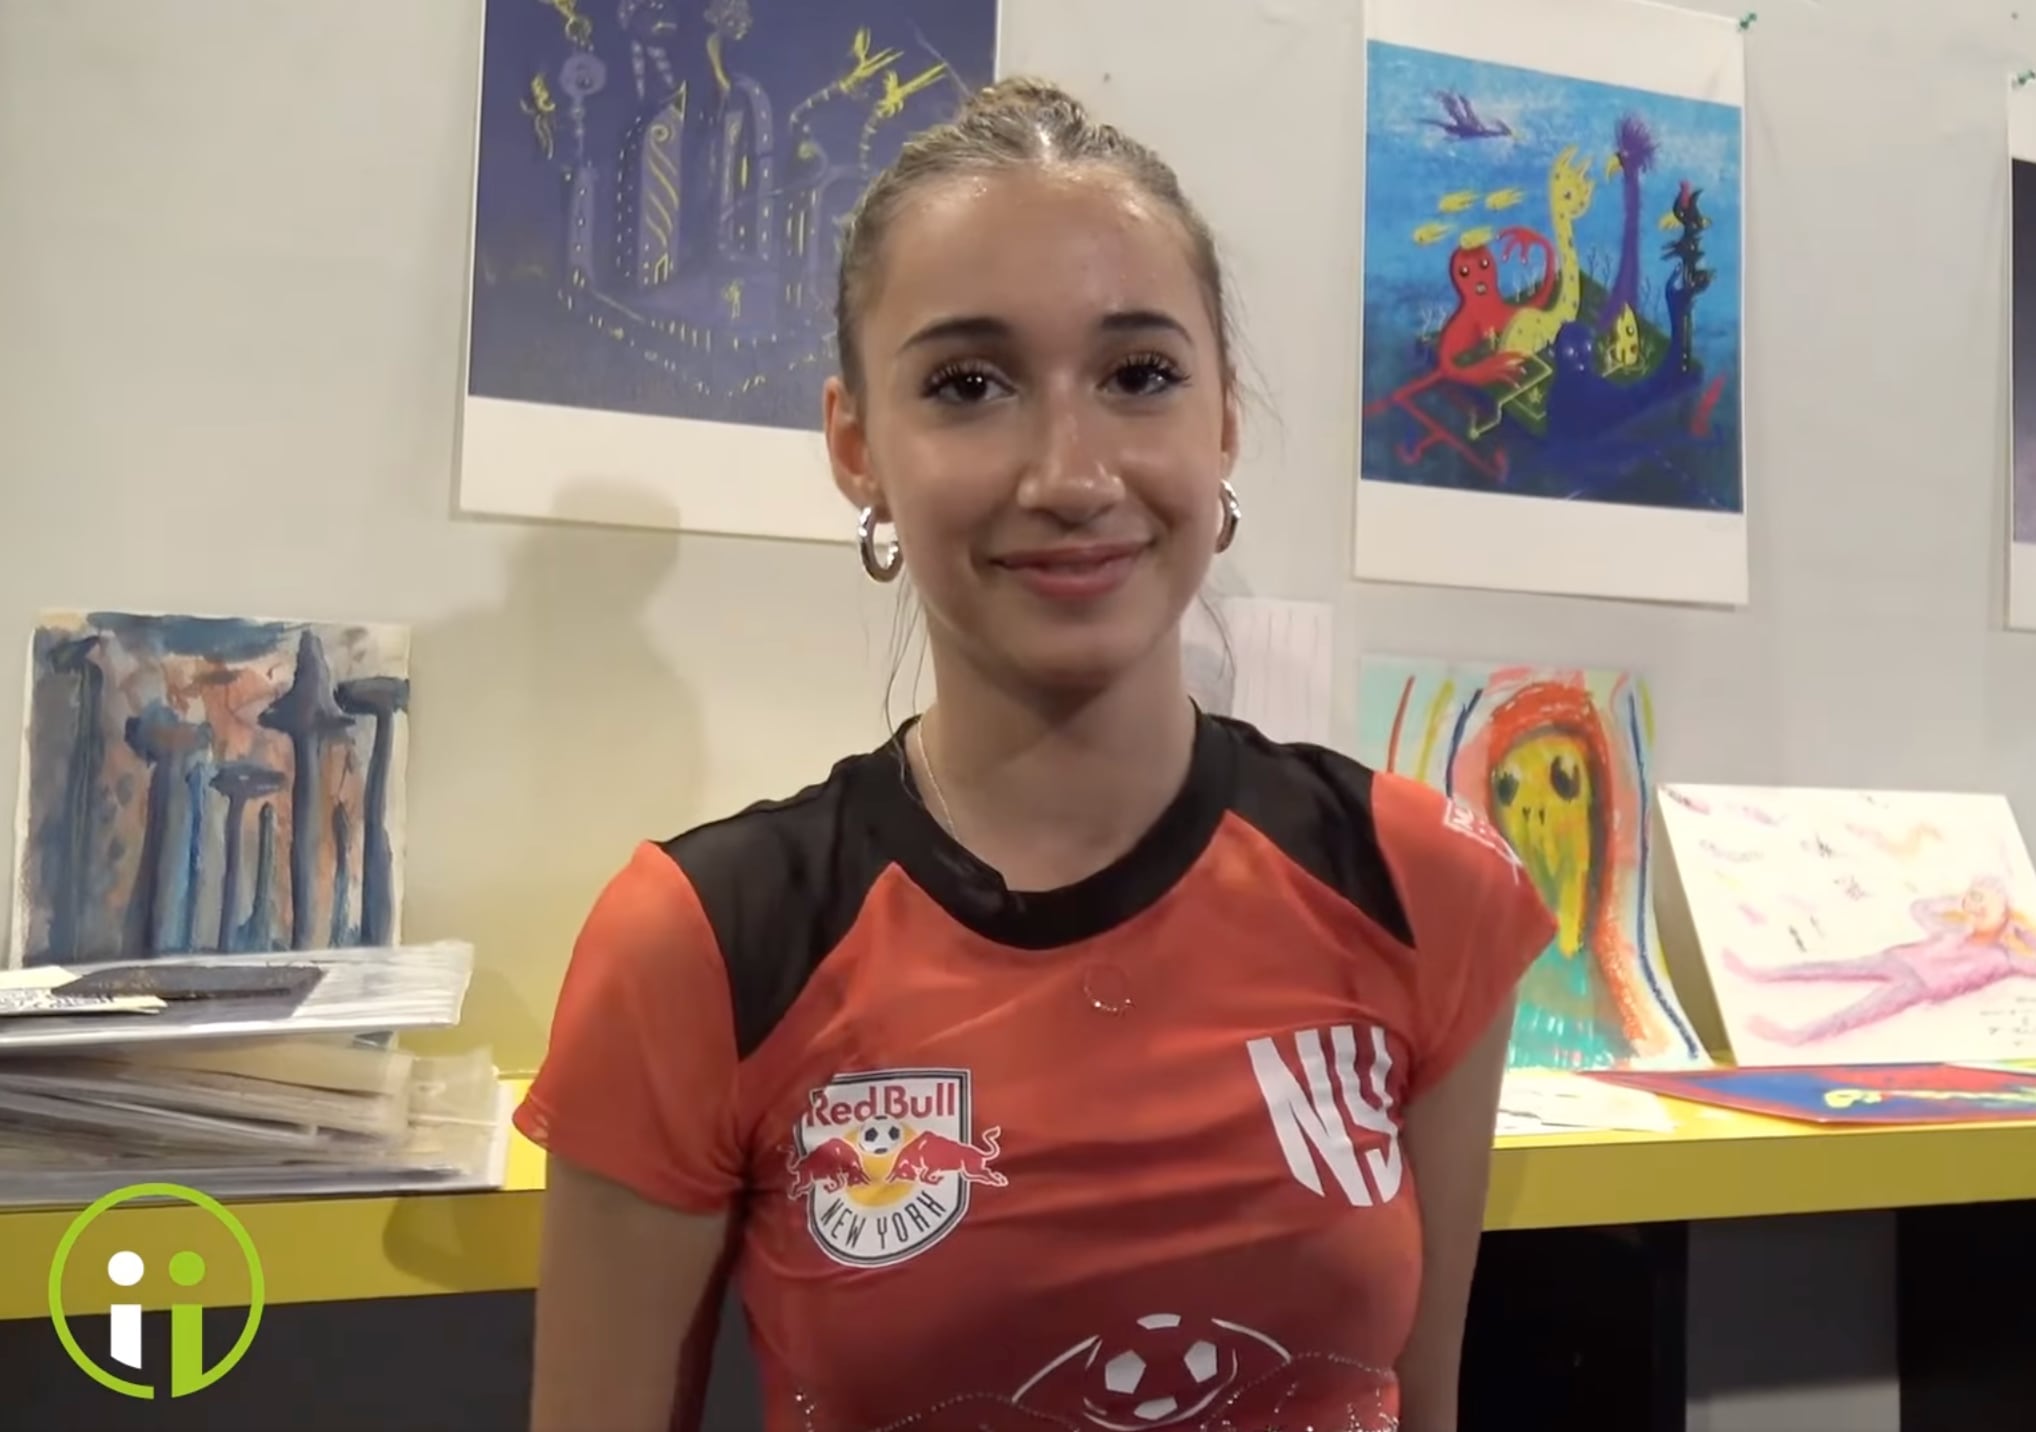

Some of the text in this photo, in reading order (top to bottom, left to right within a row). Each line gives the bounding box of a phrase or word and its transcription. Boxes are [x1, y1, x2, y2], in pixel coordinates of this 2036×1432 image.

[807, 1082, 955, 1128] Red Bull
[1246, 1025, 1403, 1207] NY
[820, 1190, 946, 1249] NEW YORK
